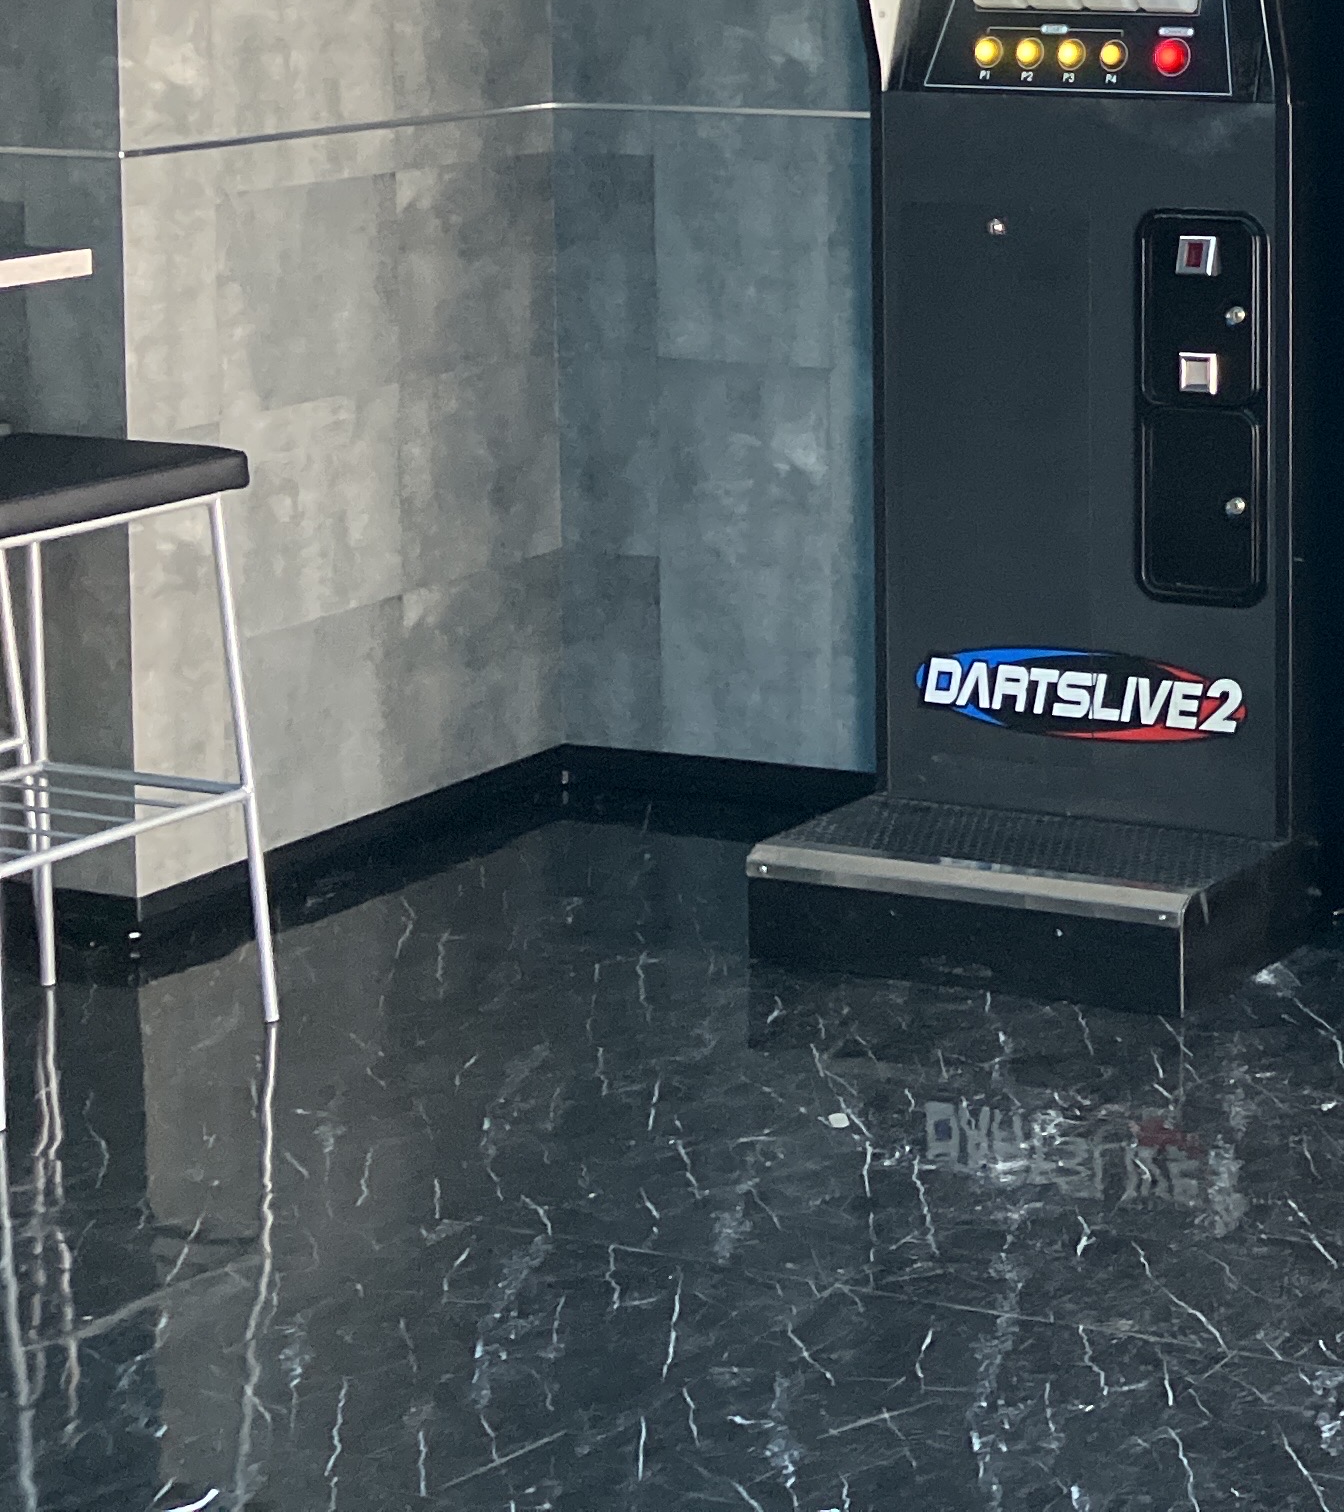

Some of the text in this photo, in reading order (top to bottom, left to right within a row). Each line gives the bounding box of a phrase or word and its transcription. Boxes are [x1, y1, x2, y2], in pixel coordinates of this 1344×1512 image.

[979, 70, 991, 80] P1
[1021, 71, 1033, 82] P2
[1062, 72, 1075, 83] P3
[1104, 73, 1117, 84] P4
[924, 657, 1243, 734] DARTSLIVE2
